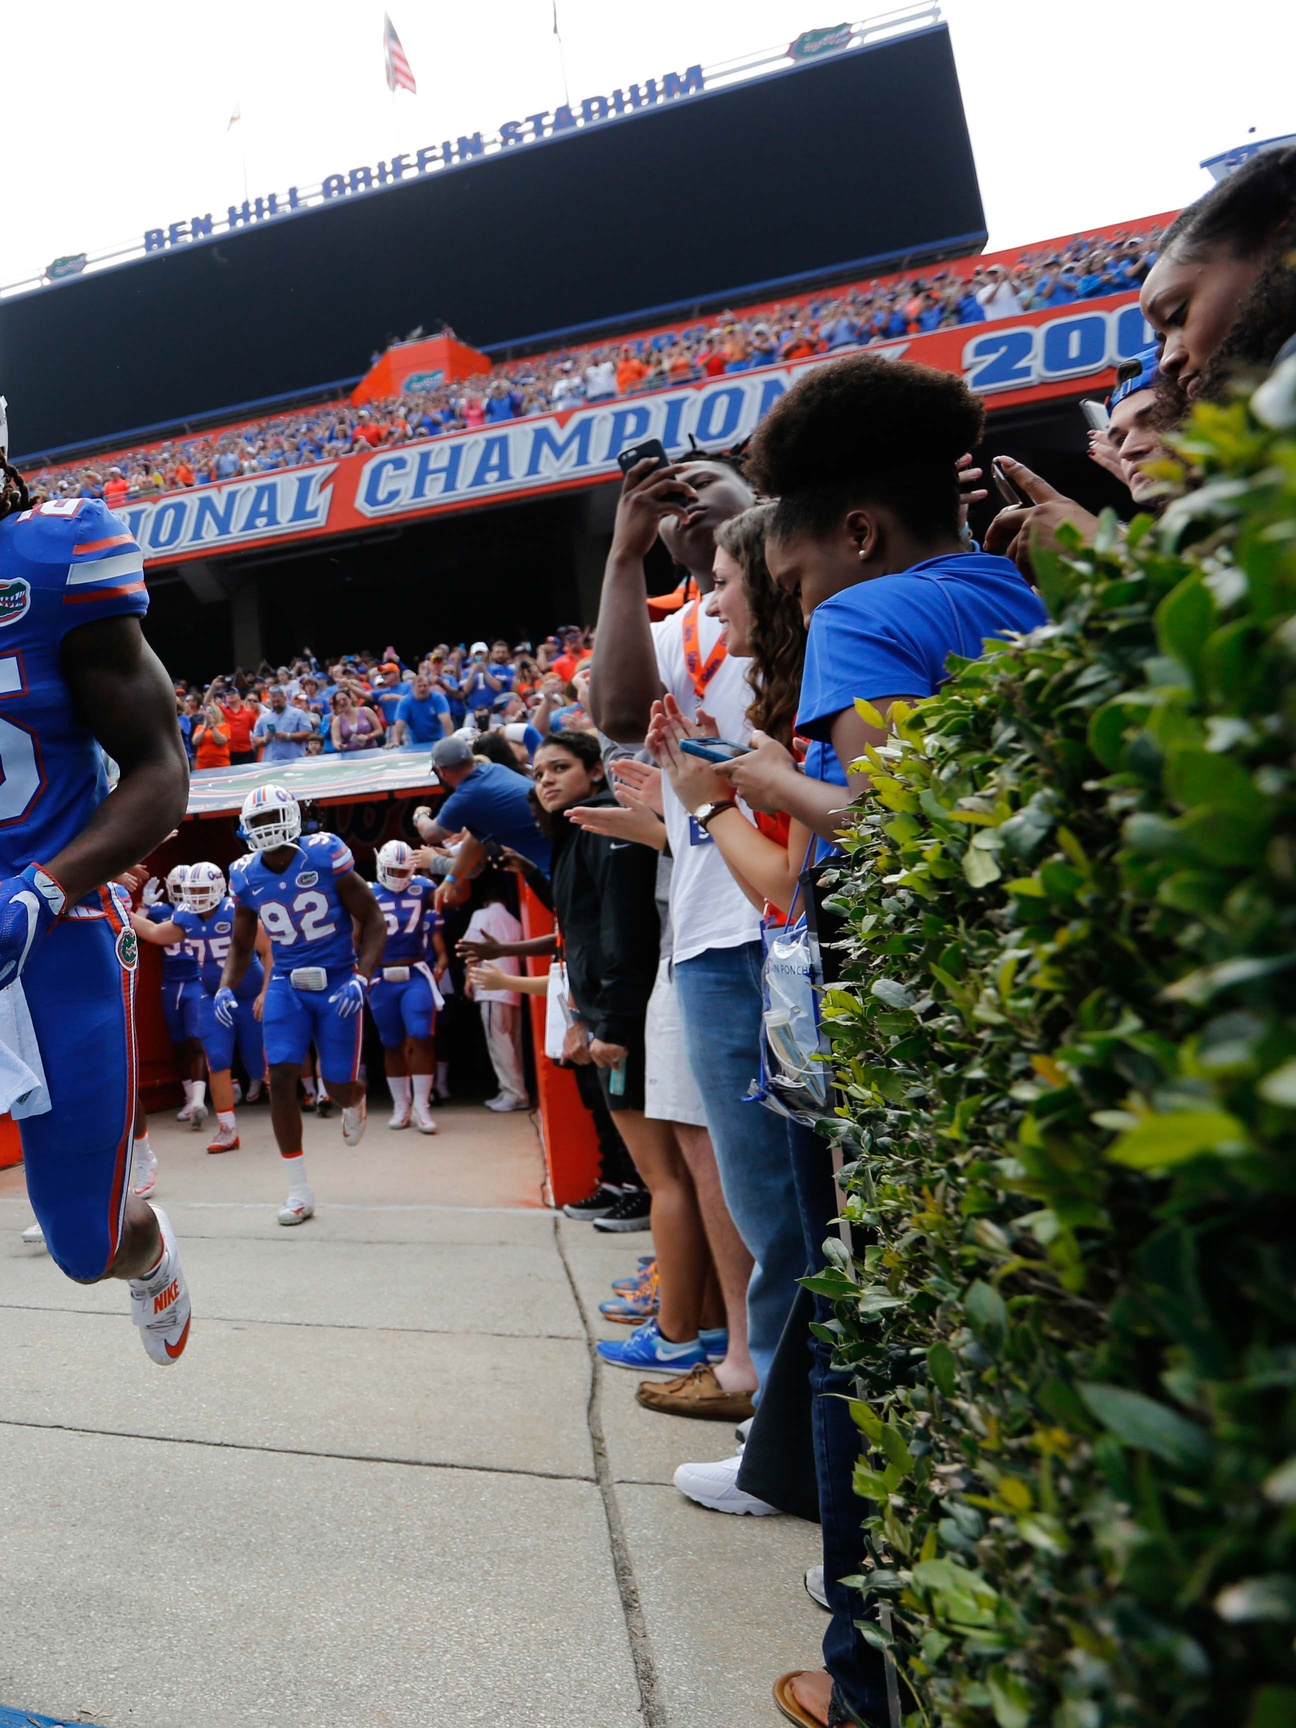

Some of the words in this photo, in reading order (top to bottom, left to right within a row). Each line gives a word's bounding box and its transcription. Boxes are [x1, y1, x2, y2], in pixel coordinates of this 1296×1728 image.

[144, 213, 212, 252] BEN
[228, 186, 307, 228] HILL
[322, 131, 482, 198] GRIFFIN
[500, 63, 705, 146] STADIUM
[128, 475, 324, 549] IONAL
[258, 889, 337, 946] 92
[154, 1277, 180, 1315] NIKE
